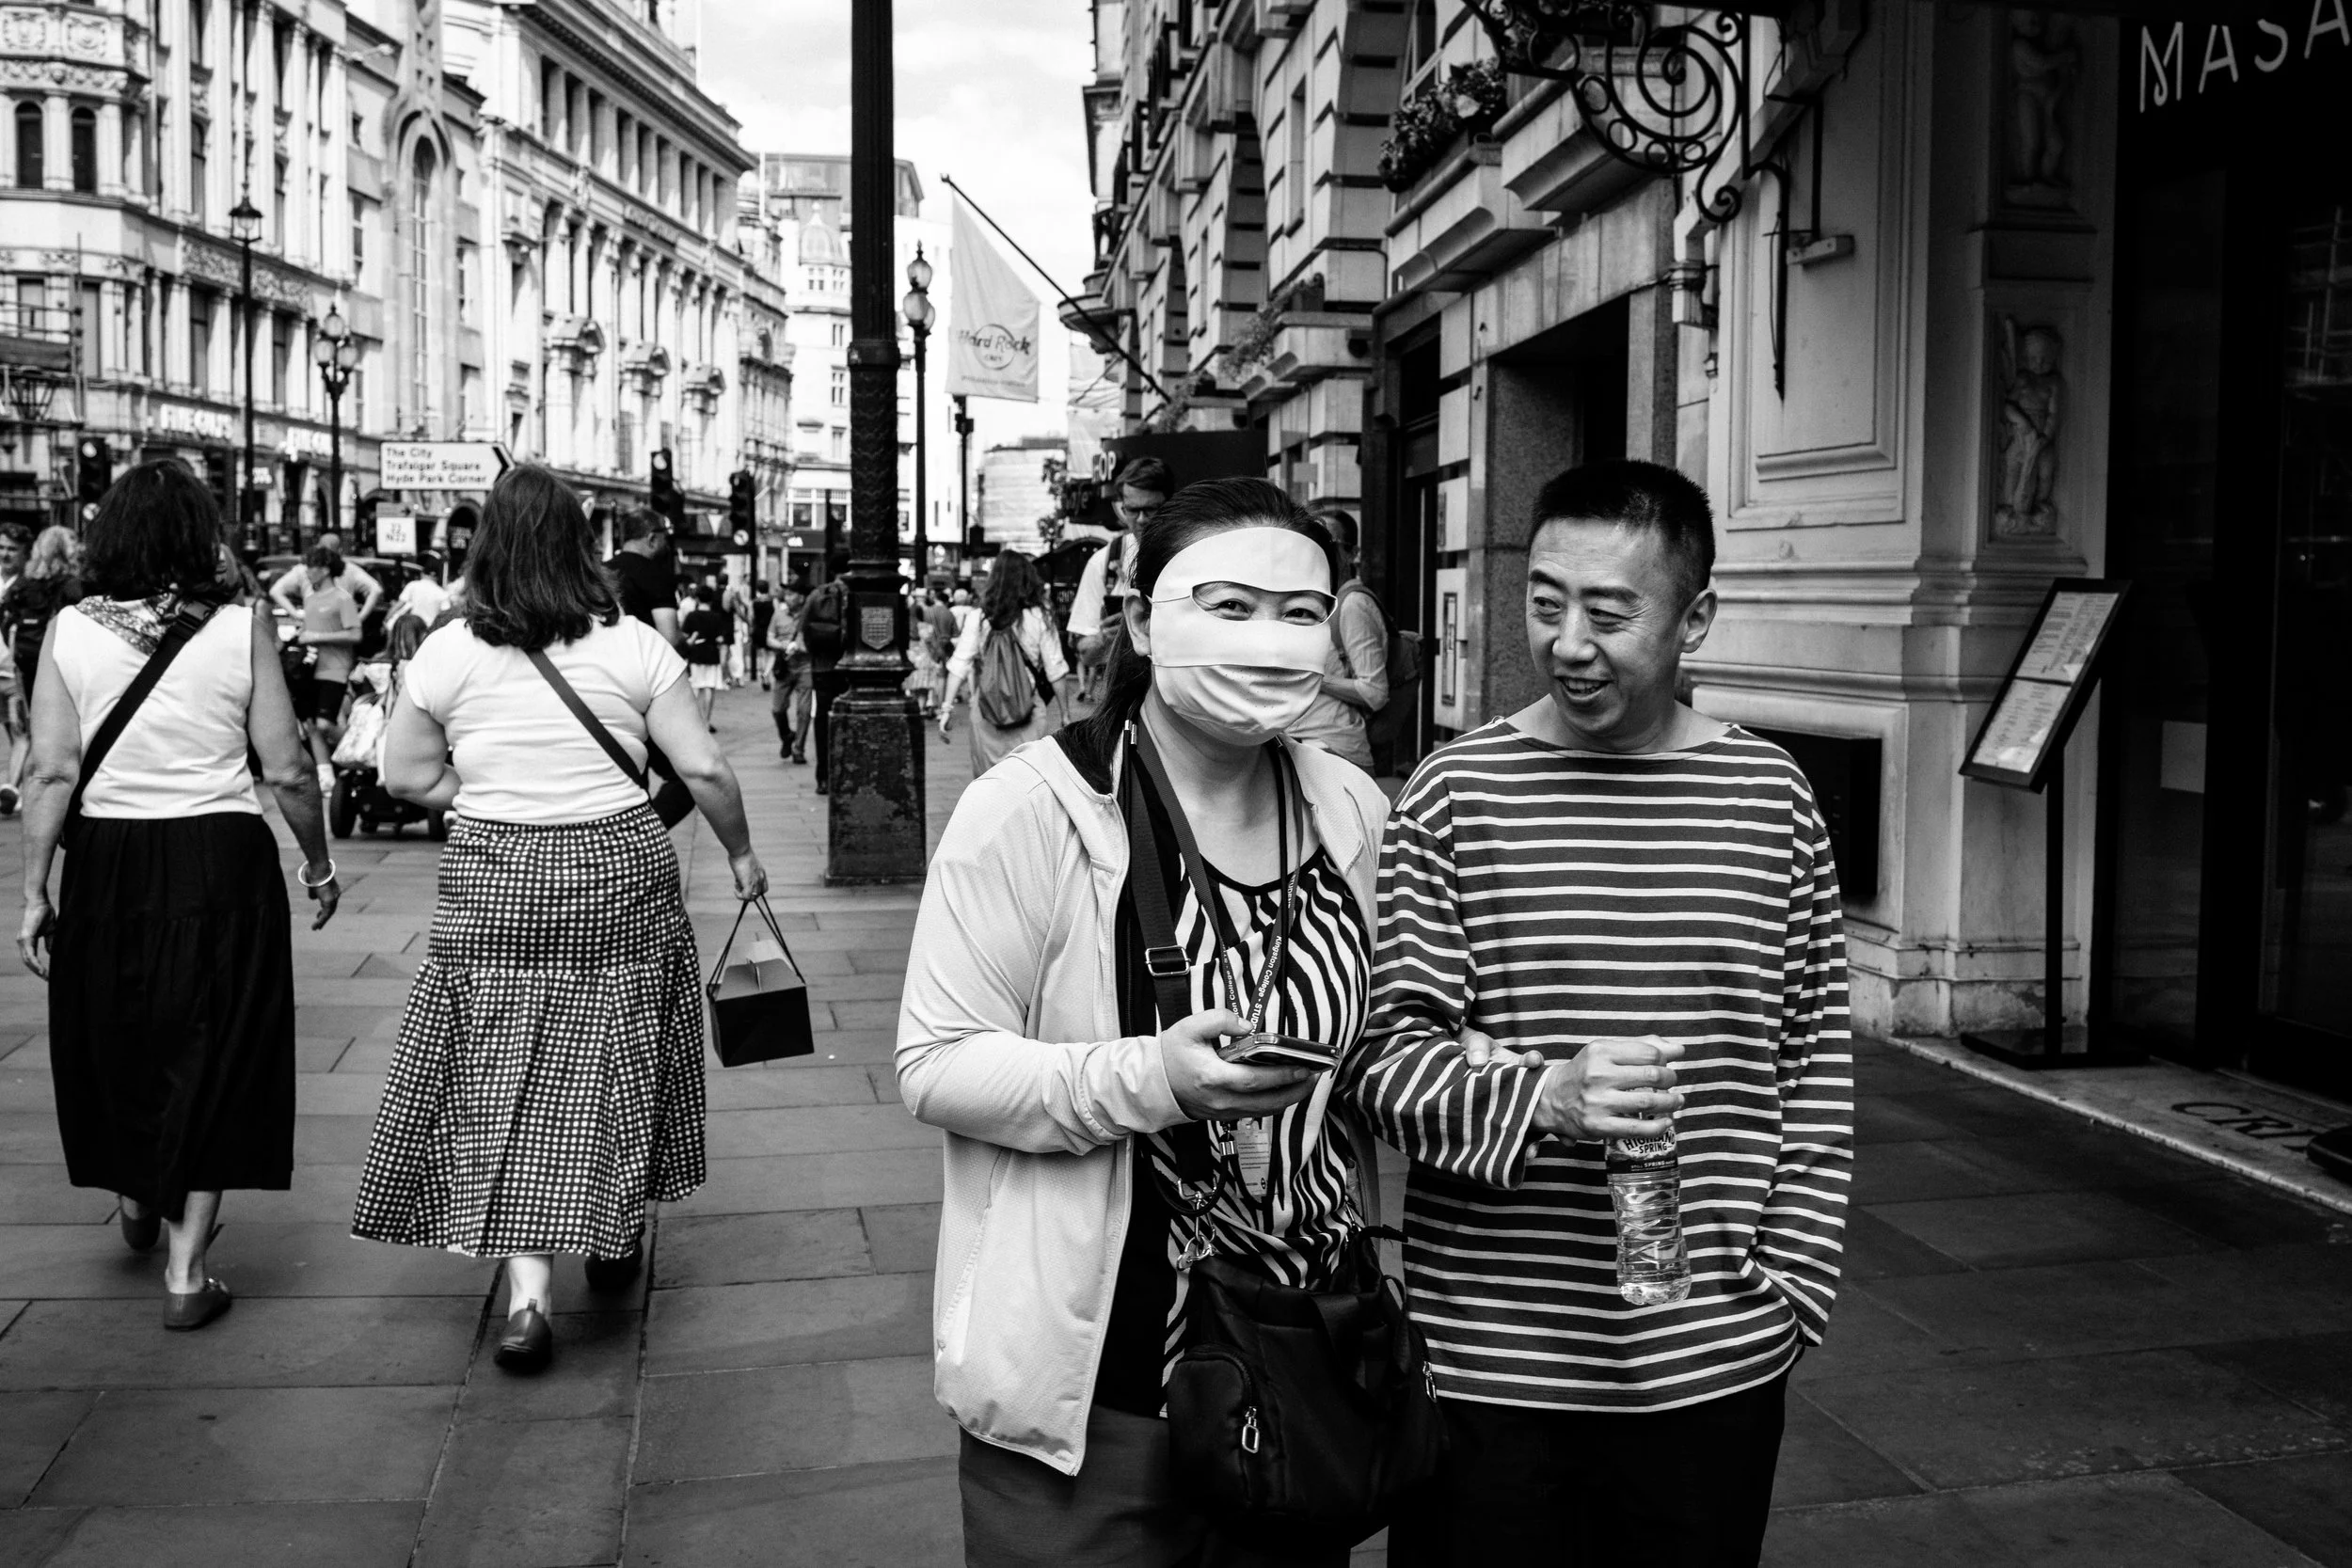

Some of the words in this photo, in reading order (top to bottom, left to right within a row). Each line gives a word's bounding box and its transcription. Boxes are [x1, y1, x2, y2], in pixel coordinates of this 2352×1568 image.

[995, 335, 1031, 356] Rock
[386, 447, 405, 457] The
[409, 447, 433, 459] City
[386, 460, 436, 472] Trafalgar
[441, 460, 481, 472] Square
[386, 473, 414, 484] Hyde
[419, 473, 443, 483] Park
[448, 473, 487, 484] Corner
[1267, 935, 1282, 969] Kingston
[1225, 970, 1236, 1001] College
[1258, 969, 1273, 998] College
[1639, 1142, 1668, 1154] SPRING
